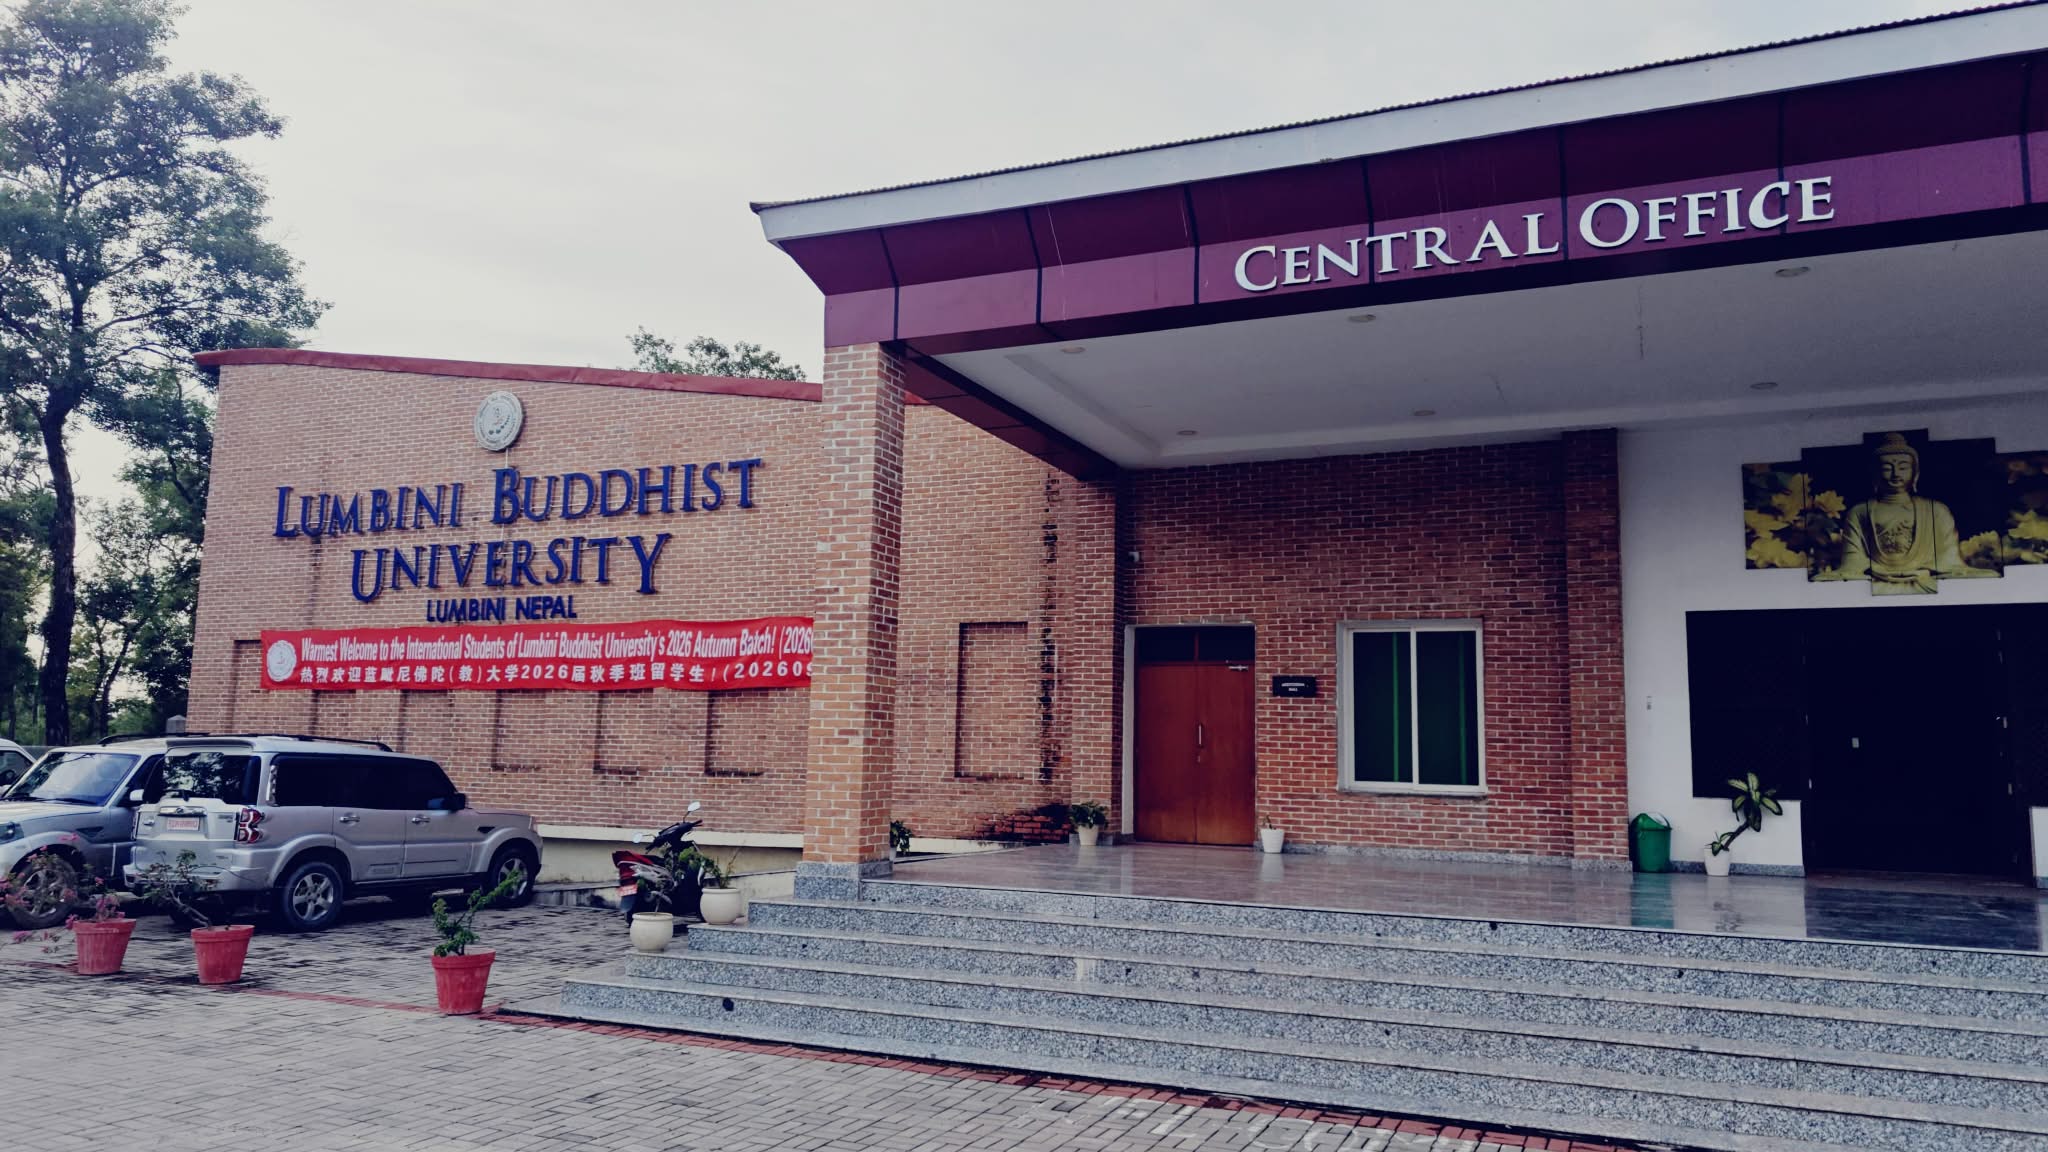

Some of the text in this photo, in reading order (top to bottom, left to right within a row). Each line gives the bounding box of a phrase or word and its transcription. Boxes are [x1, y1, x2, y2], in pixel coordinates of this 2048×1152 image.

[1234, 175, 1836, 293] CENTRAL OFFICE
[273, 457, 763, 539] LUMBINI BUDDHIST
[350, 532, 673, 603] UNIVERSITY
[301, 637, 338, 662] Warmest
[340, 636, 378, 661] Welcome
[380, 639, 389, 661] to
[390, 636, 405, 660] the
[406, 635, 464, 660] International
[464, 633, 505, 659] Students
[506, 632, 519, 658] of
[518, 631, 559, 658] Lumbini
[558, 631, 603, 659] Buddhist
[666, 630, 692, 657] 2026
[692, 631, 737, 658] Autumn
[739, 626, 777, 657] Batch!
[426, 595, 577, 624] LUMBINI NEPAL
